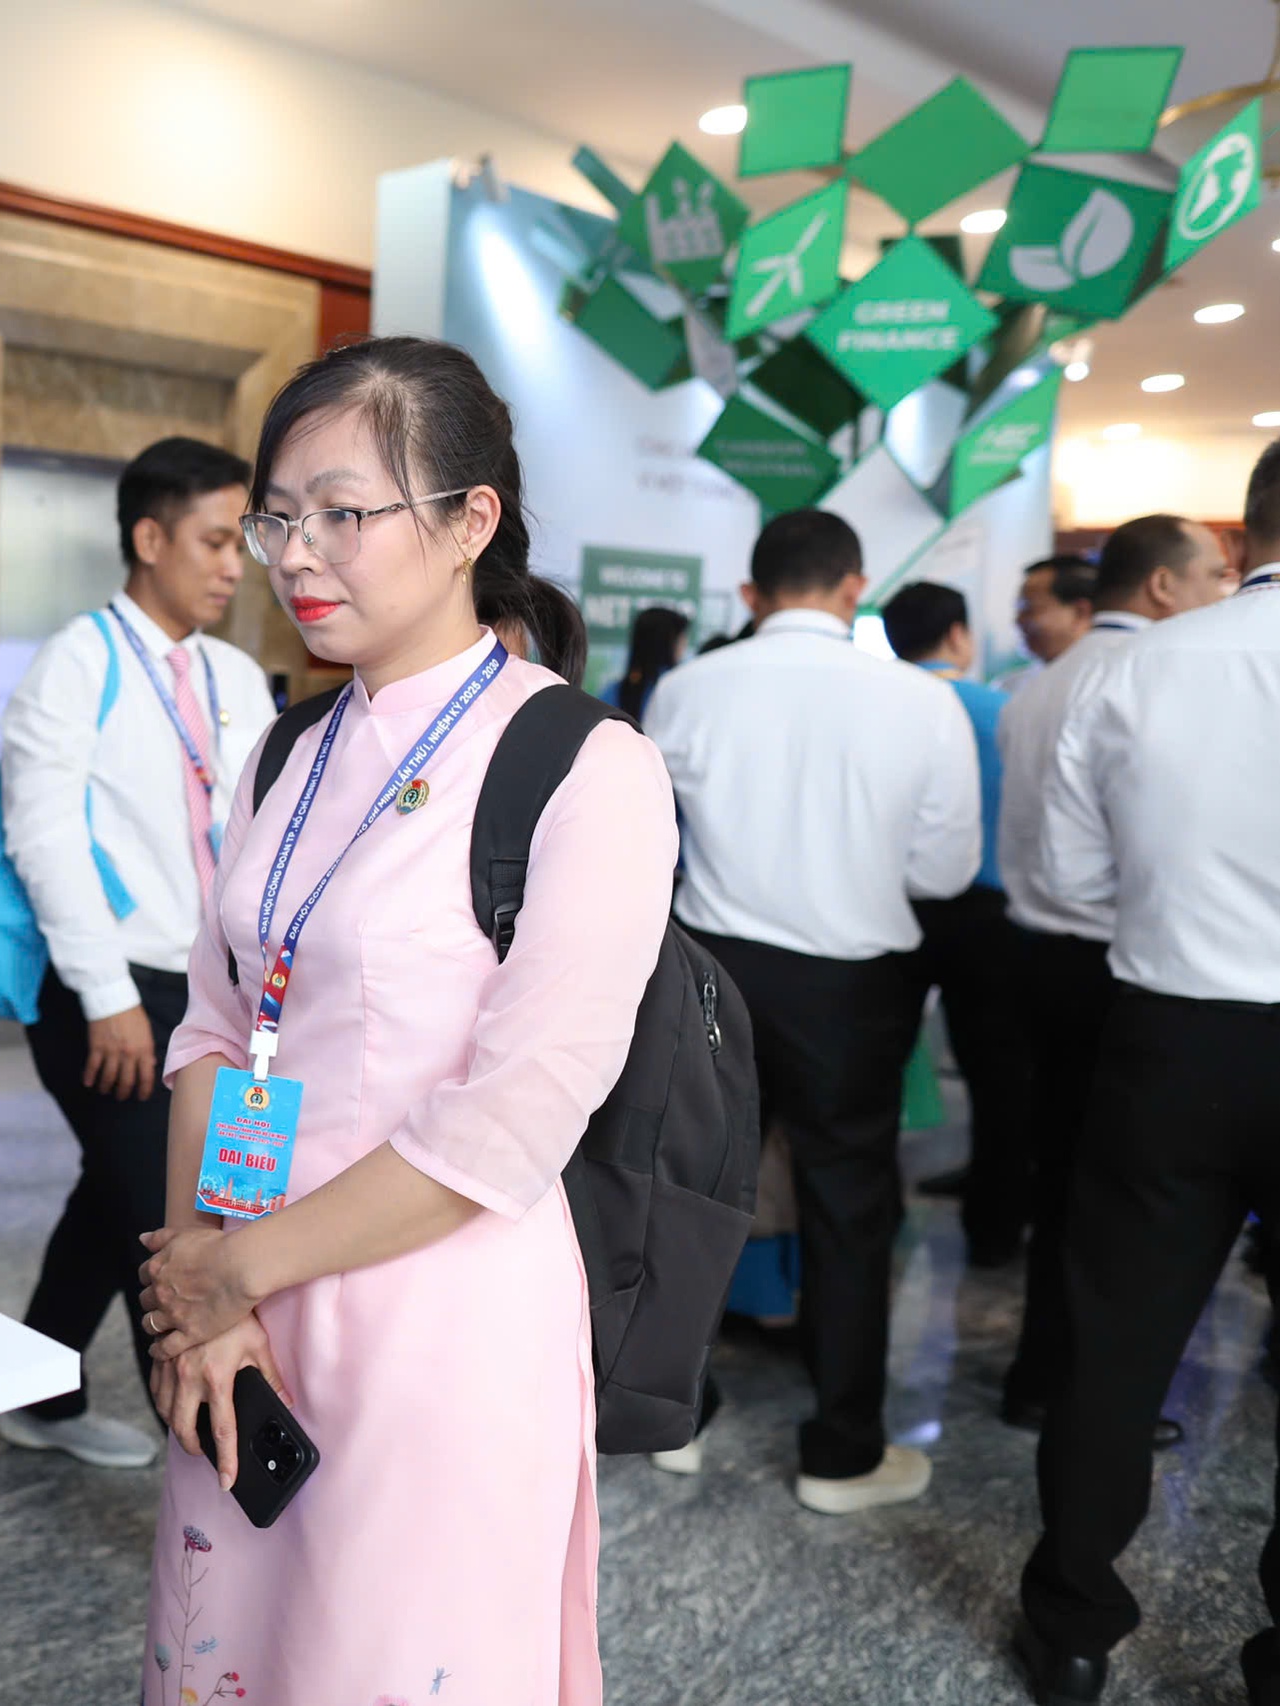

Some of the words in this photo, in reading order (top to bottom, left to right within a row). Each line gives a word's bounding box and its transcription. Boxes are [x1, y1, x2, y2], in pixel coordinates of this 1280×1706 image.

[855, 300, 950, 325] GREEN
[837, 328, 958, 351] FINANCE
[379, 785, 399, 809] MINH
[428, 713, 454, 744] NHIỆM
[460, 681, 481, 704] 2025
[482, 658, 500, 679] 2030
